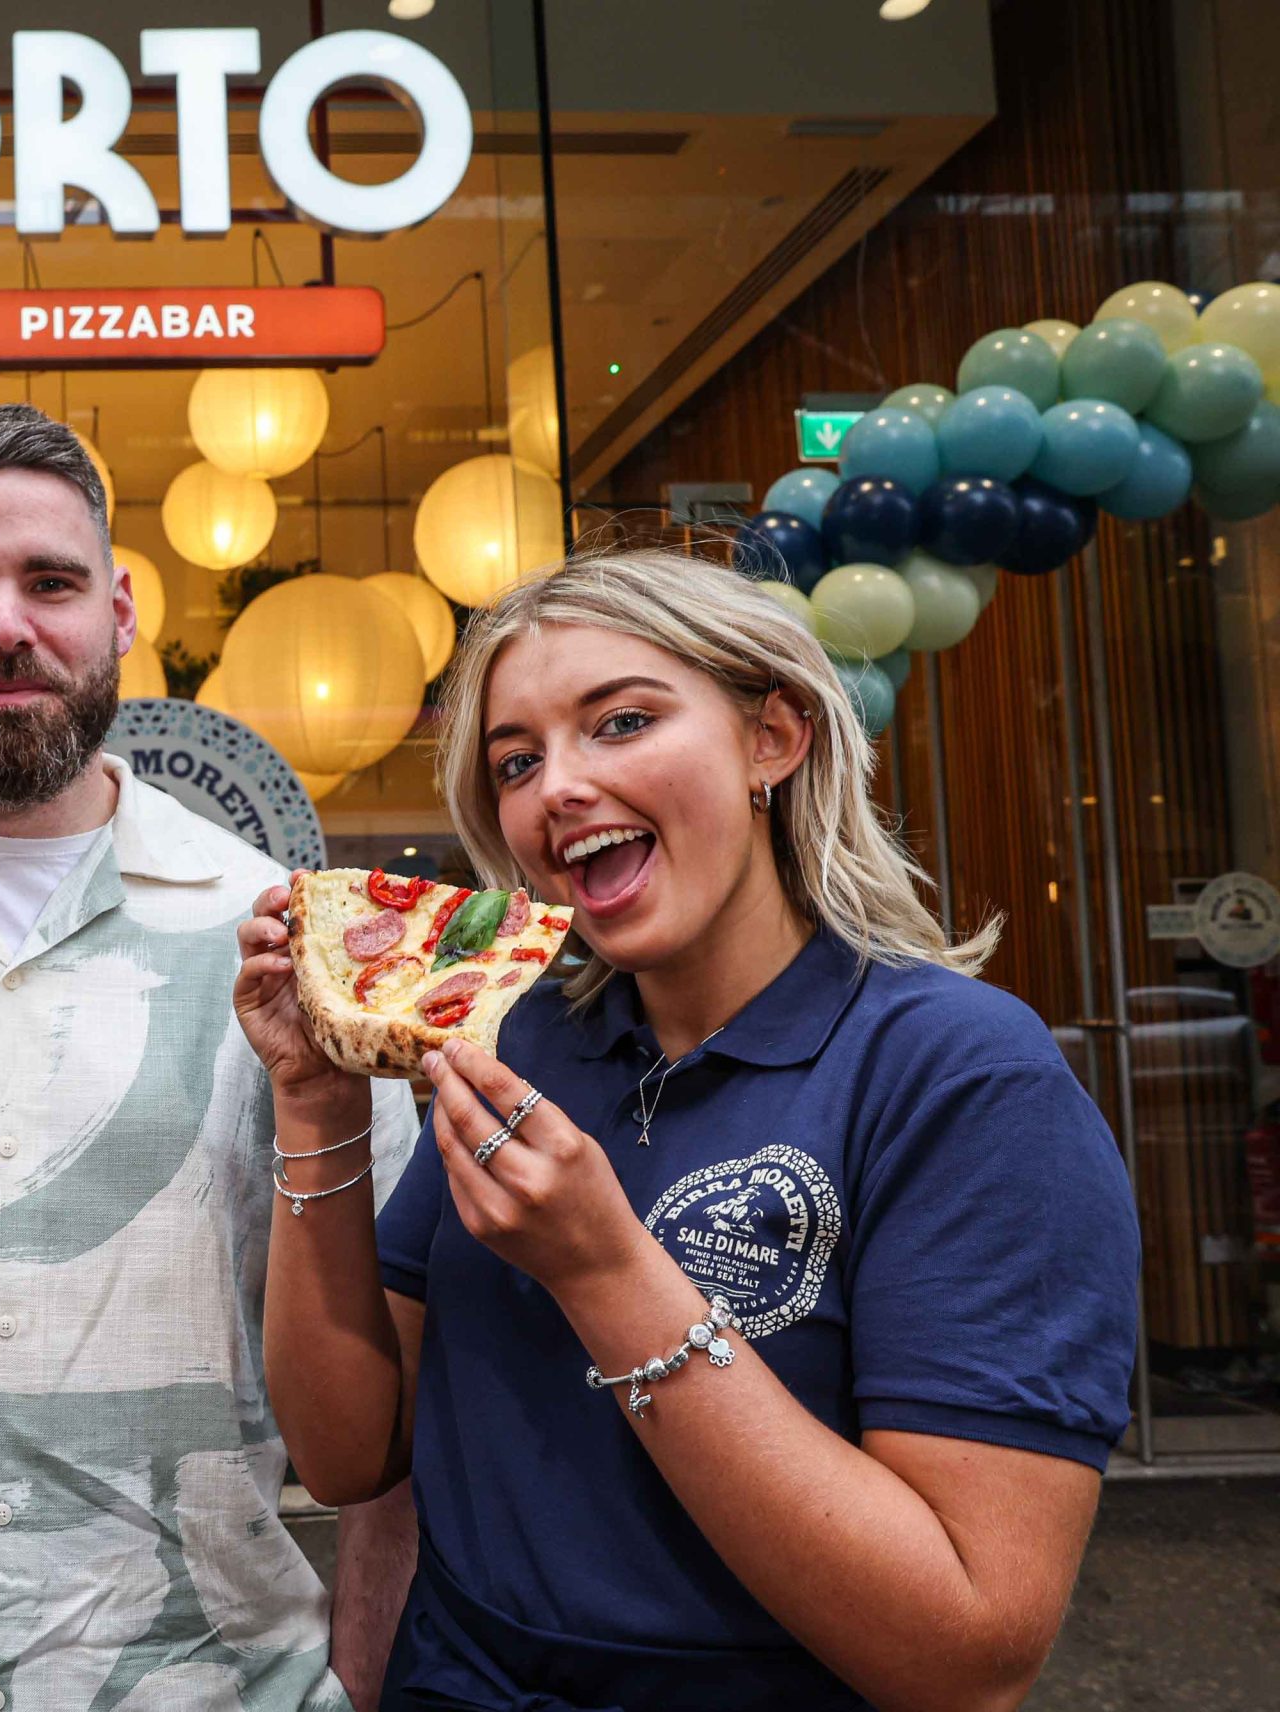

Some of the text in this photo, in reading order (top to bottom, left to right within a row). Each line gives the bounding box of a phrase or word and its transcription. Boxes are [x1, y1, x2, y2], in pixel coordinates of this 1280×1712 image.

[20, 304, 256, 341] PIZZABAR
[131, 748, 272, 857] MORETT
[664, 1168, 810, 1252] BIRRA MORETTI
[676, 1227, 715, 1249] SALE
[715, 1235, 734, 1254] DI
[734, 1240, 780, 1266] MARE
[685, 1247, 760, 1273] BREWED WITH PASSION
[680, 1261, 760, 1289] ITALIAN SEA SALT
[694, 1257, 709, 1267] AND
[716, 1263, 737, 1274] PINCH
[774, 1261, 799, 1296] LAGER
